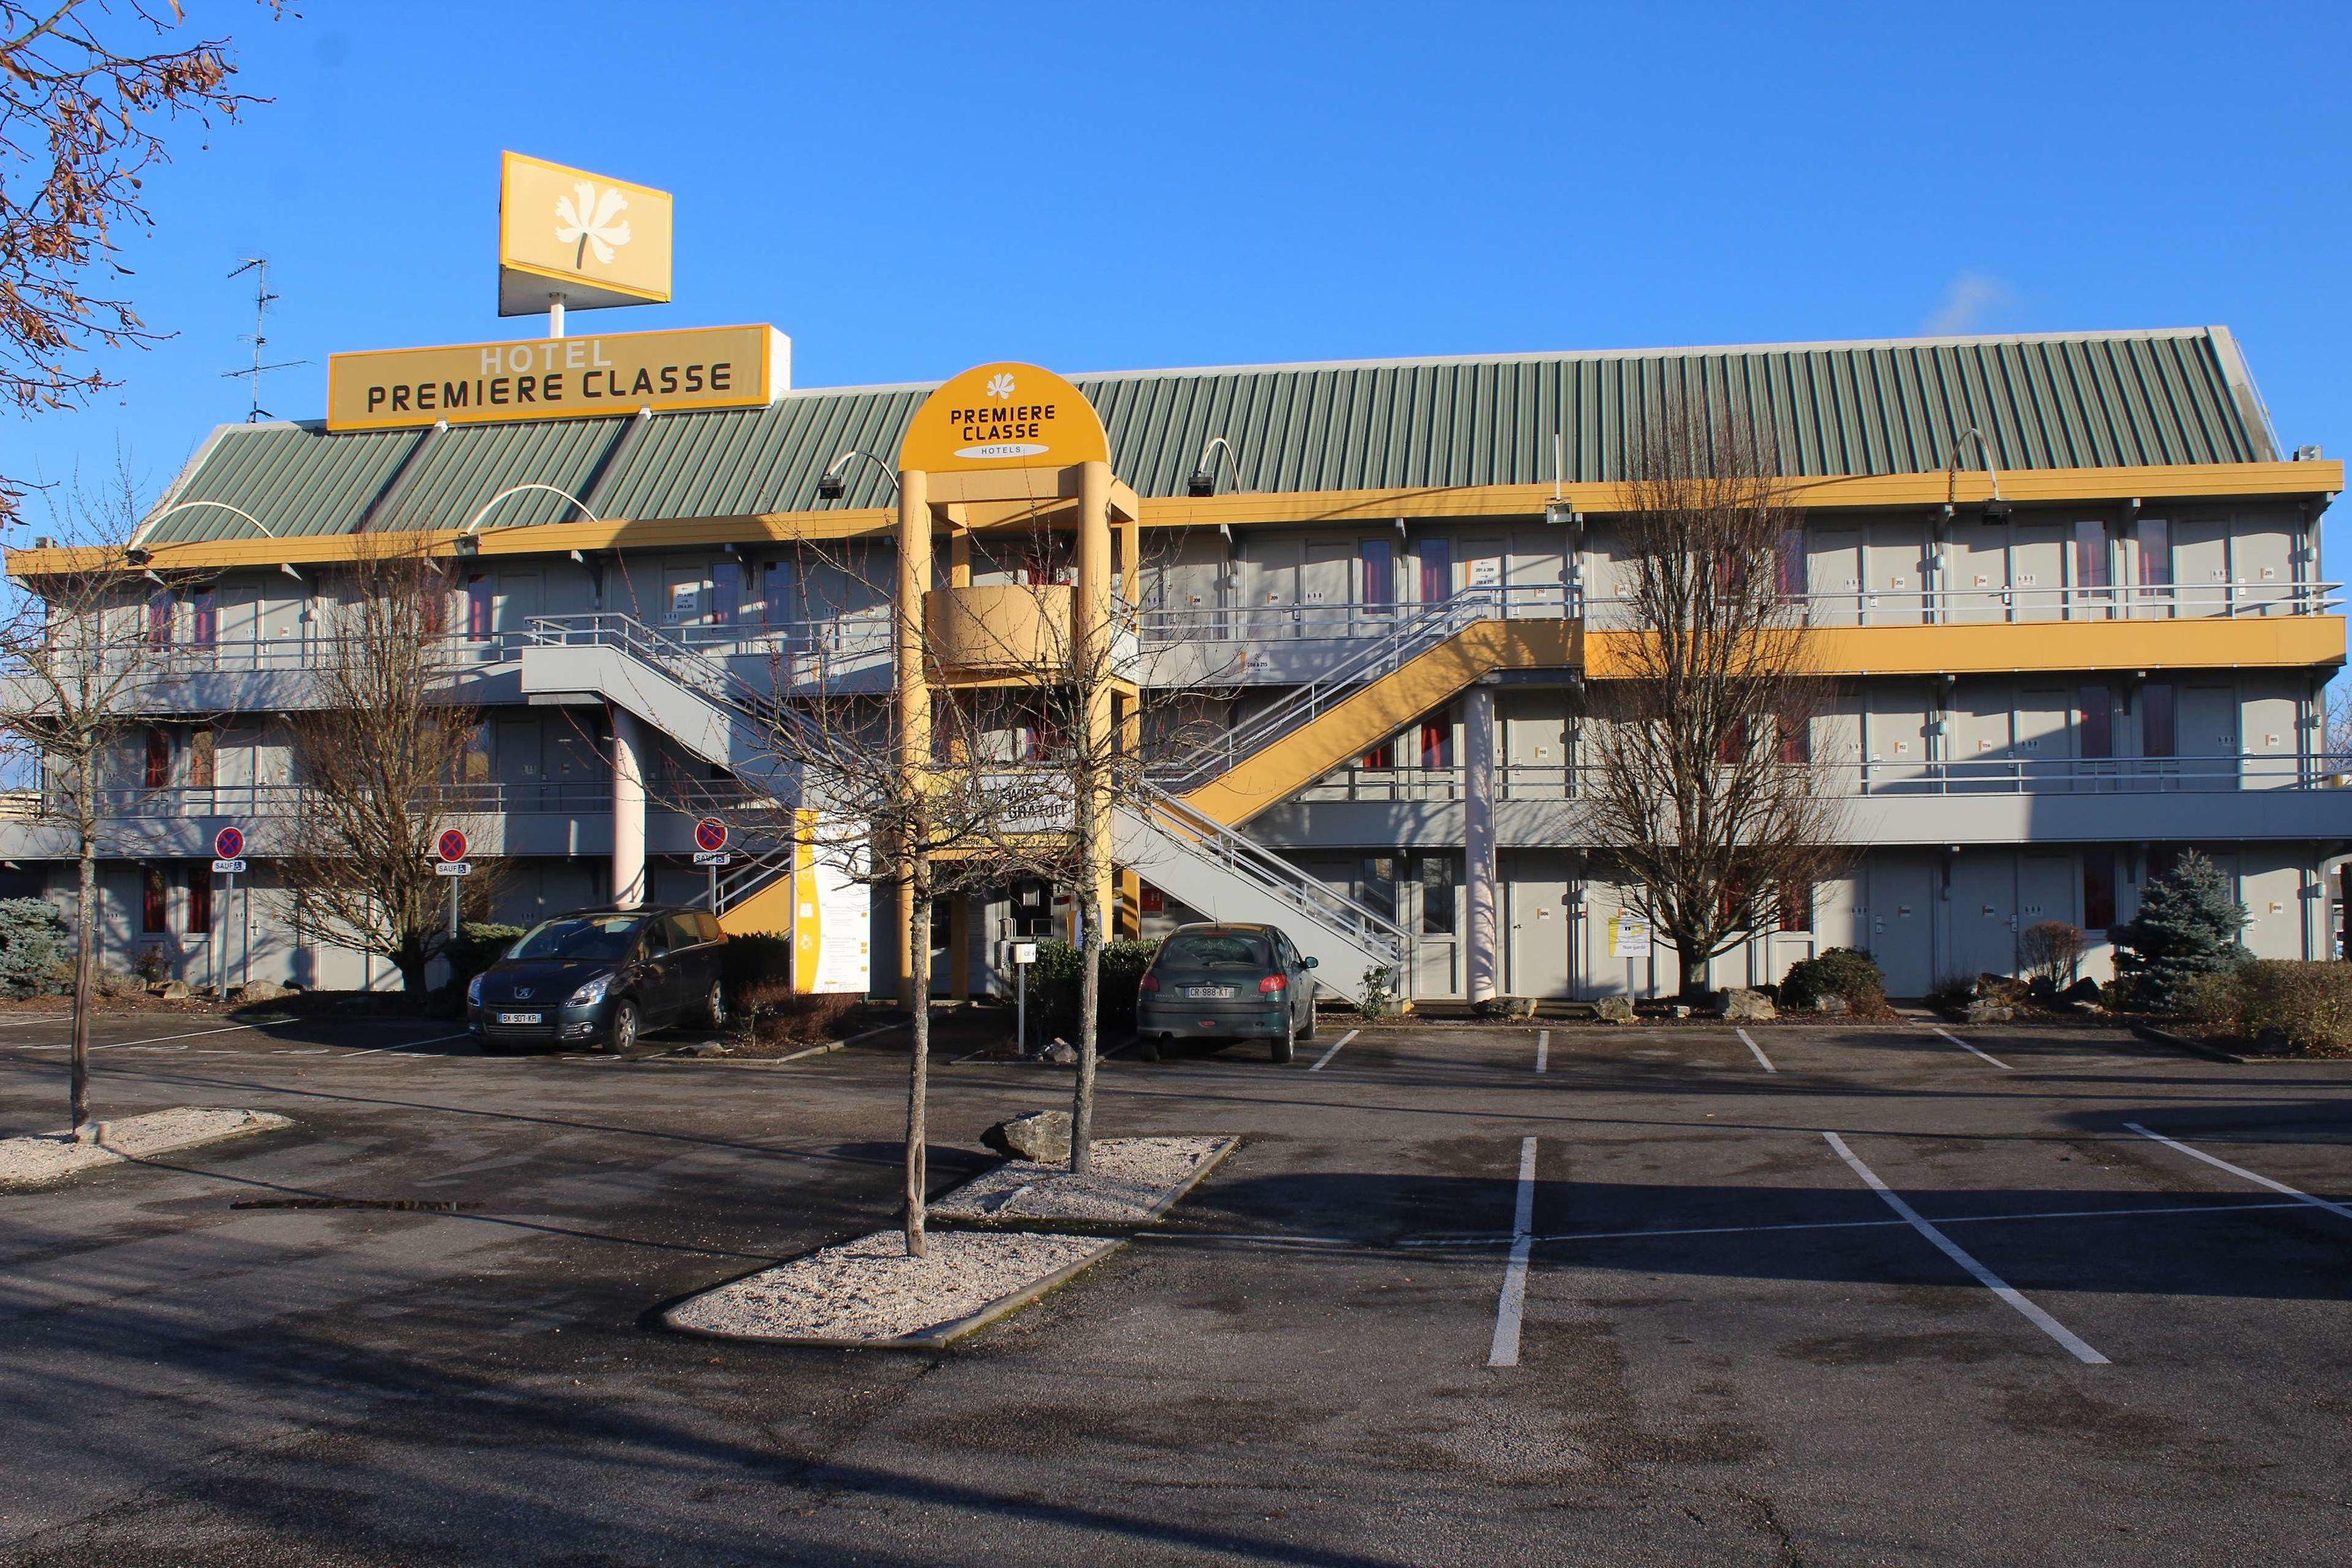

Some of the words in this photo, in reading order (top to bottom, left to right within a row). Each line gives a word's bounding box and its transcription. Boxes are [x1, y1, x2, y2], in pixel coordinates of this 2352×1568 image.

[482, 340, 611, 375] HOTEL
[367, 373, 563, 413] PREMIERE
[583, 362, 732, 399] CLASSE
[950, 404, 1055, 425] PREMIERE
[963, 422, 1039, 441] CLASSE
[981, 446, 1021, 454] HOTELS
[1190, 988, 1228, 997] CR-988-KT
